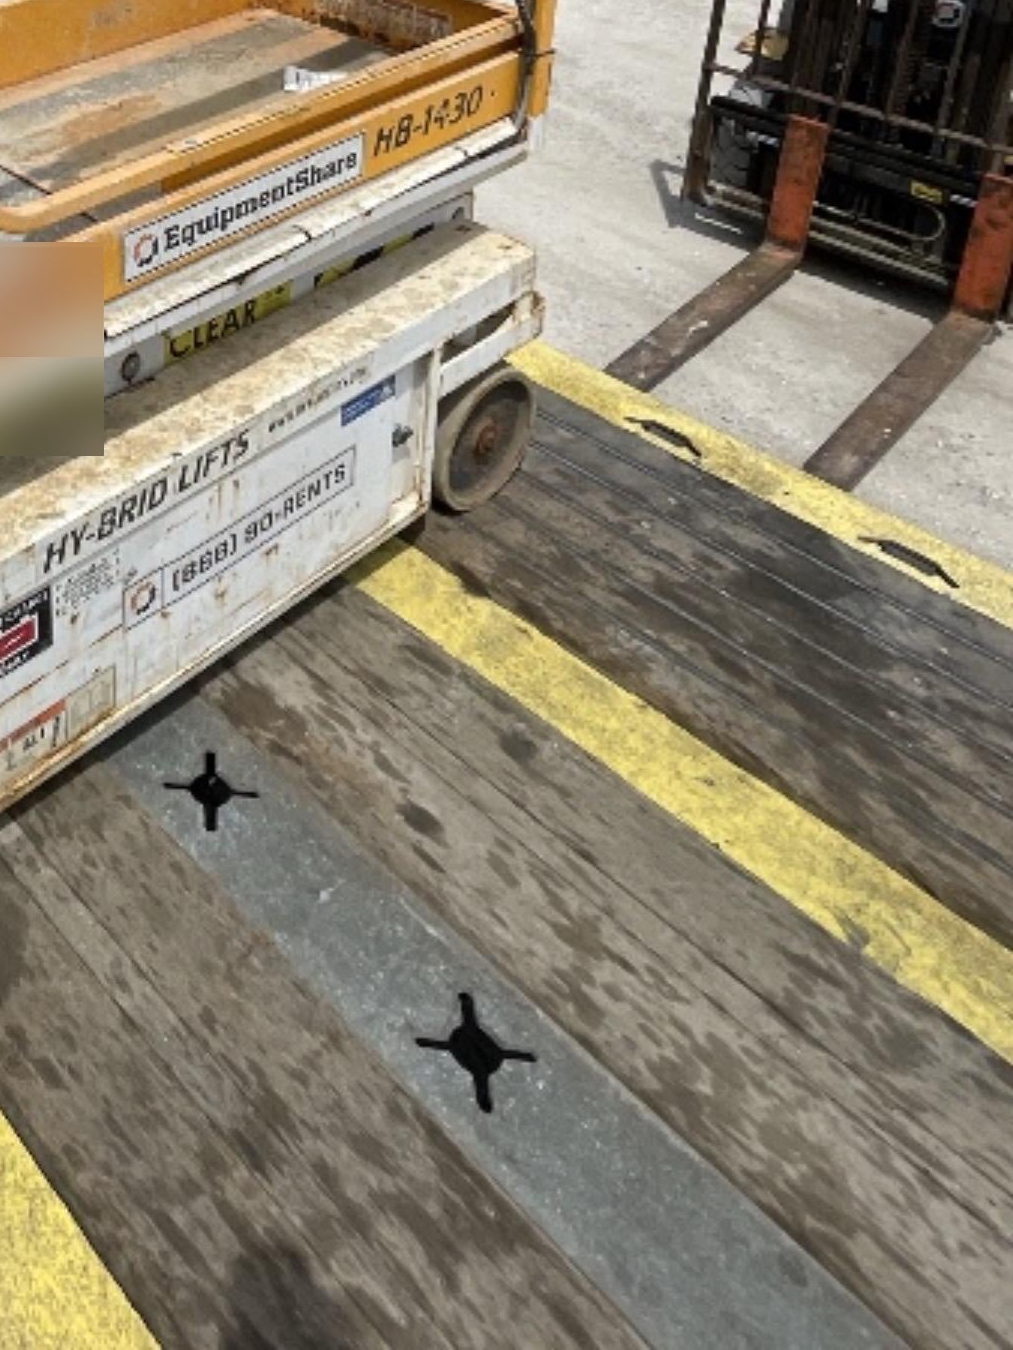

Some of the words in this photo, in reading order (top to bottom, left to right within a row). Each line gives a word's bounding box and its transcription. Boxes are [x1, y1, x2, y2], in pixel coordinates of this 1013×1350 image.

[374, 85, 483, 156] HB-1430
[163, 152, 358, 251] EquipmentShare
[169, 298, 257, 358] CLEAR
[43, 477, 168, 574] HY-BRID
[178, 428, 250, 493] LIFTS
[244, 463, 346, 544] 90-RENTS
